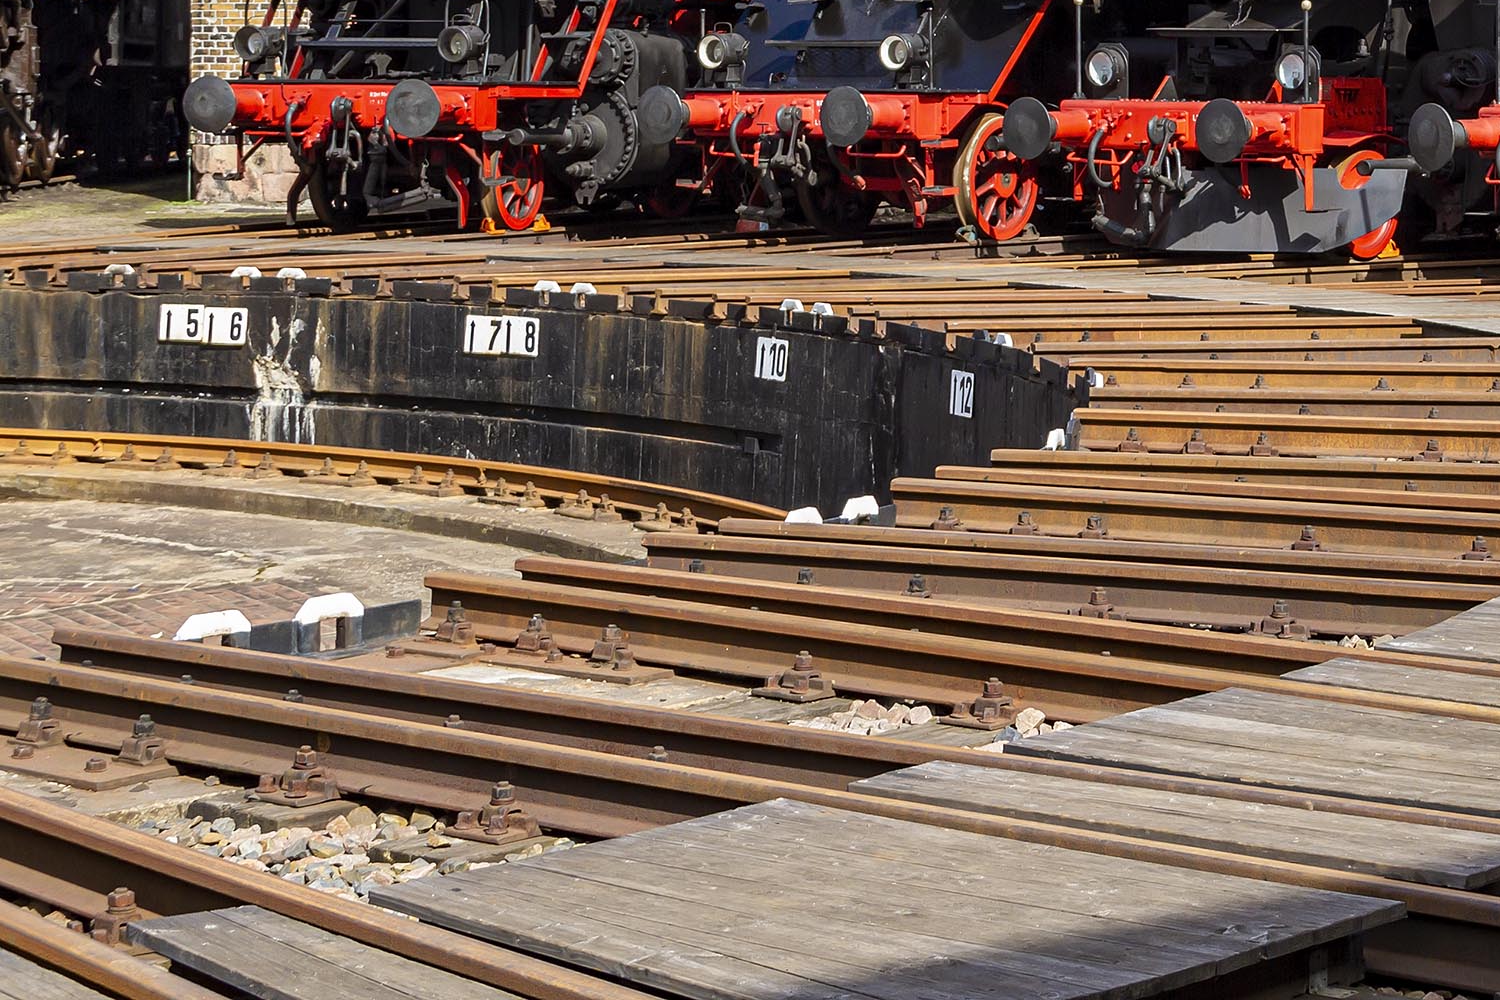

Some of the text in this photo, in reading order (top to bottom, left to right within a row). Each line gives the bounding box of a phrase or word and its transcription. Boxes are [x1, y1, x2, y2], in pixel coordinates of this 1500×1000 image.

[186, 308, 199, 338] 5
[230, 311, 243, 341] 6
[488, 319, 502, 351] 7
[525, 320, 536, 353] 8
[769, 343, 786, 377] 10
[959, 376, 973, 414] 12
